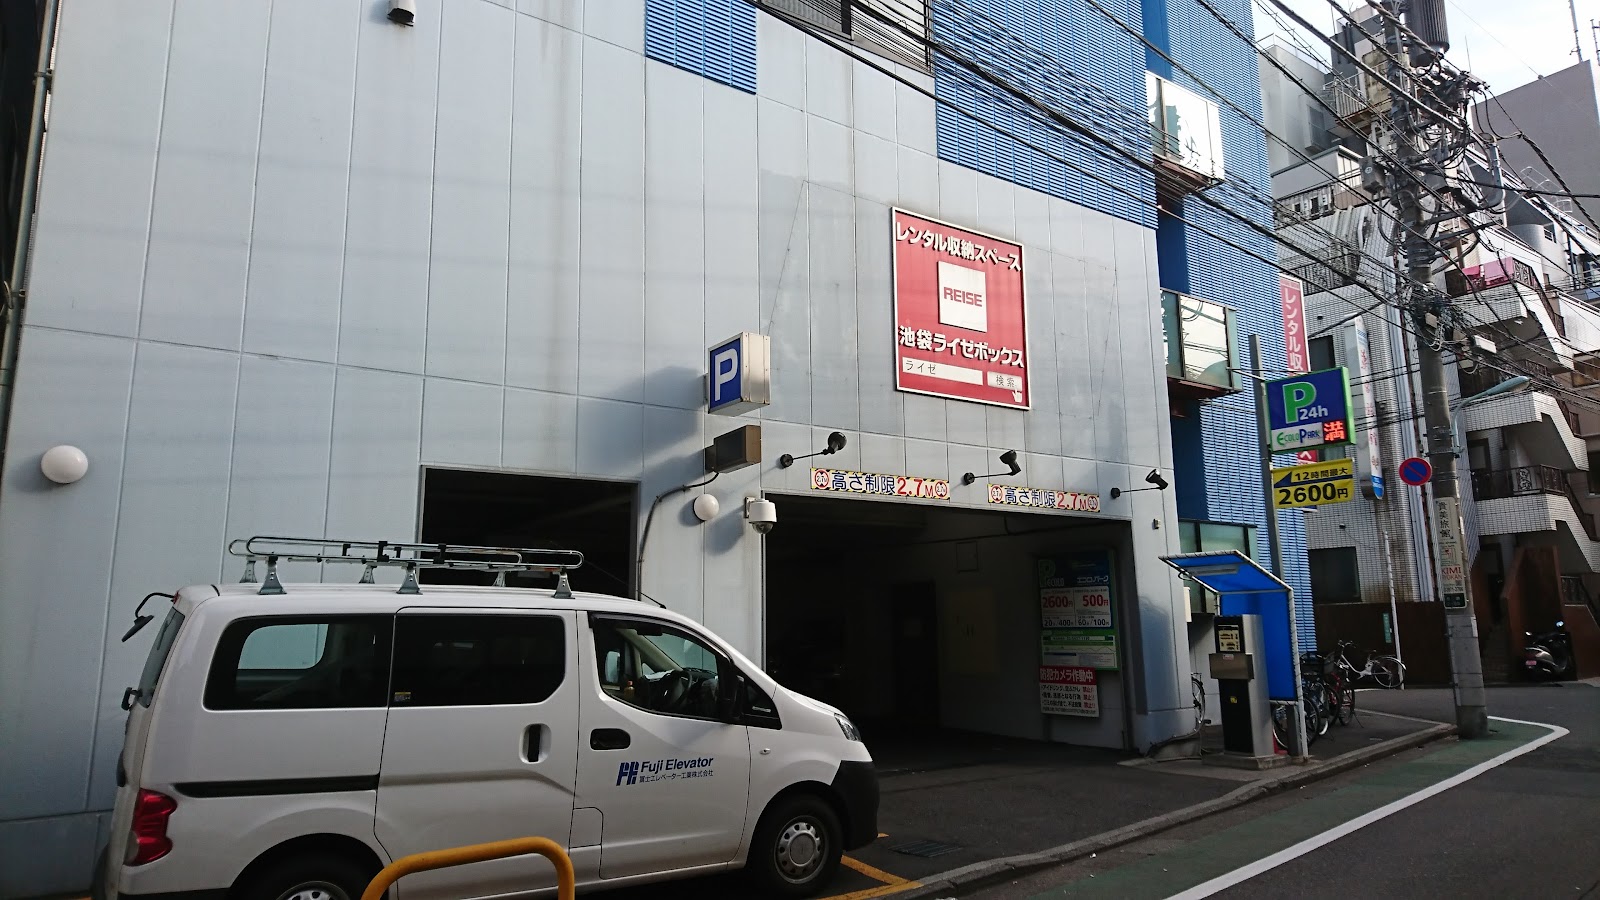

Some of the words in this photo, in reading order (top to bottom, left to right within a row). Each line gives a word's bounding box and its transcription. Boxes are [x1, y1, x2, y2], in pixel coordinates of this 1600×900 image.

[896, 221, 1022, 271] レンタル収納スペース
[943, 286, 983, 307] REISE
[1284, 286, 1304, 371] レンタル収
[899, 325, 1024, 368] 池袋ライゼボックス
[714, 348, 738, 402] P
[905, 360, 937, 375] ライゼ
[995, 374, 1016, 388] 検索
[1282, 381, 1317, 424] P
[1299, 405, 1328, 420] 24h
[1323, 420, 1345, 441] 満
[1294, 467, 1348, 481] 12時間最大
[1278, 482, 1348, 505] 2600円
[1082, 594, 1109, 607] 500円
[1039, 668, 1094, 683] 防犯カメラ作動中
[640, 759, 664, 775] Fuji
[665, 757, 714, 771] Elevator
